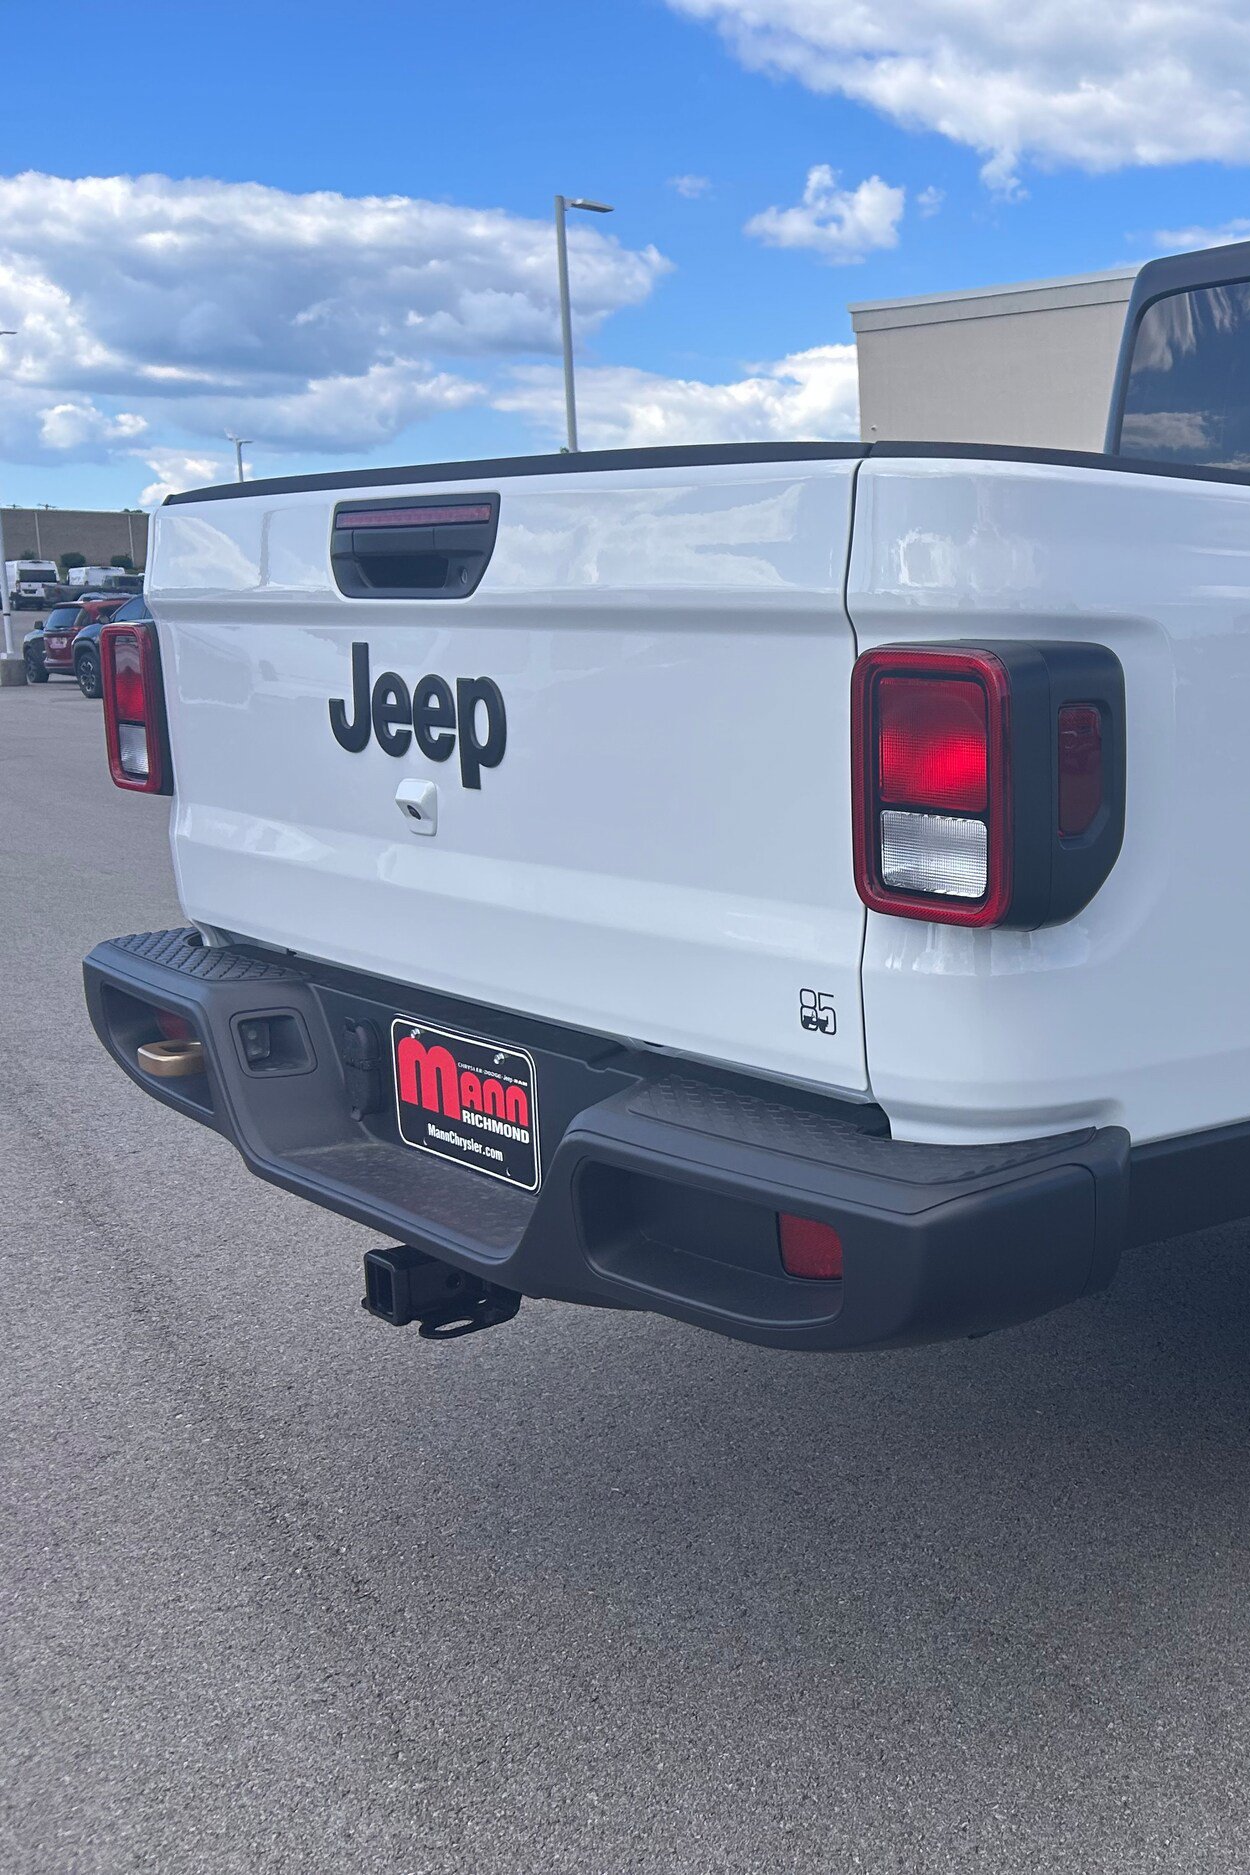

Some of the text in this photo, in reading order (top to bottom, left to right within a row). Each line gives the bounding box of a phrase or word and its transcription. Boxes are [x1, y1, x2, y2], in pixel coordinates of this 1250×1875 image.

[328, 641, 507, 790] Jeep
[799, 987, 837, 1036] 85
[427, 1123, 504, 1162] MannChrysler.com
[462, 1109, 530, 1144] RICHMOND
